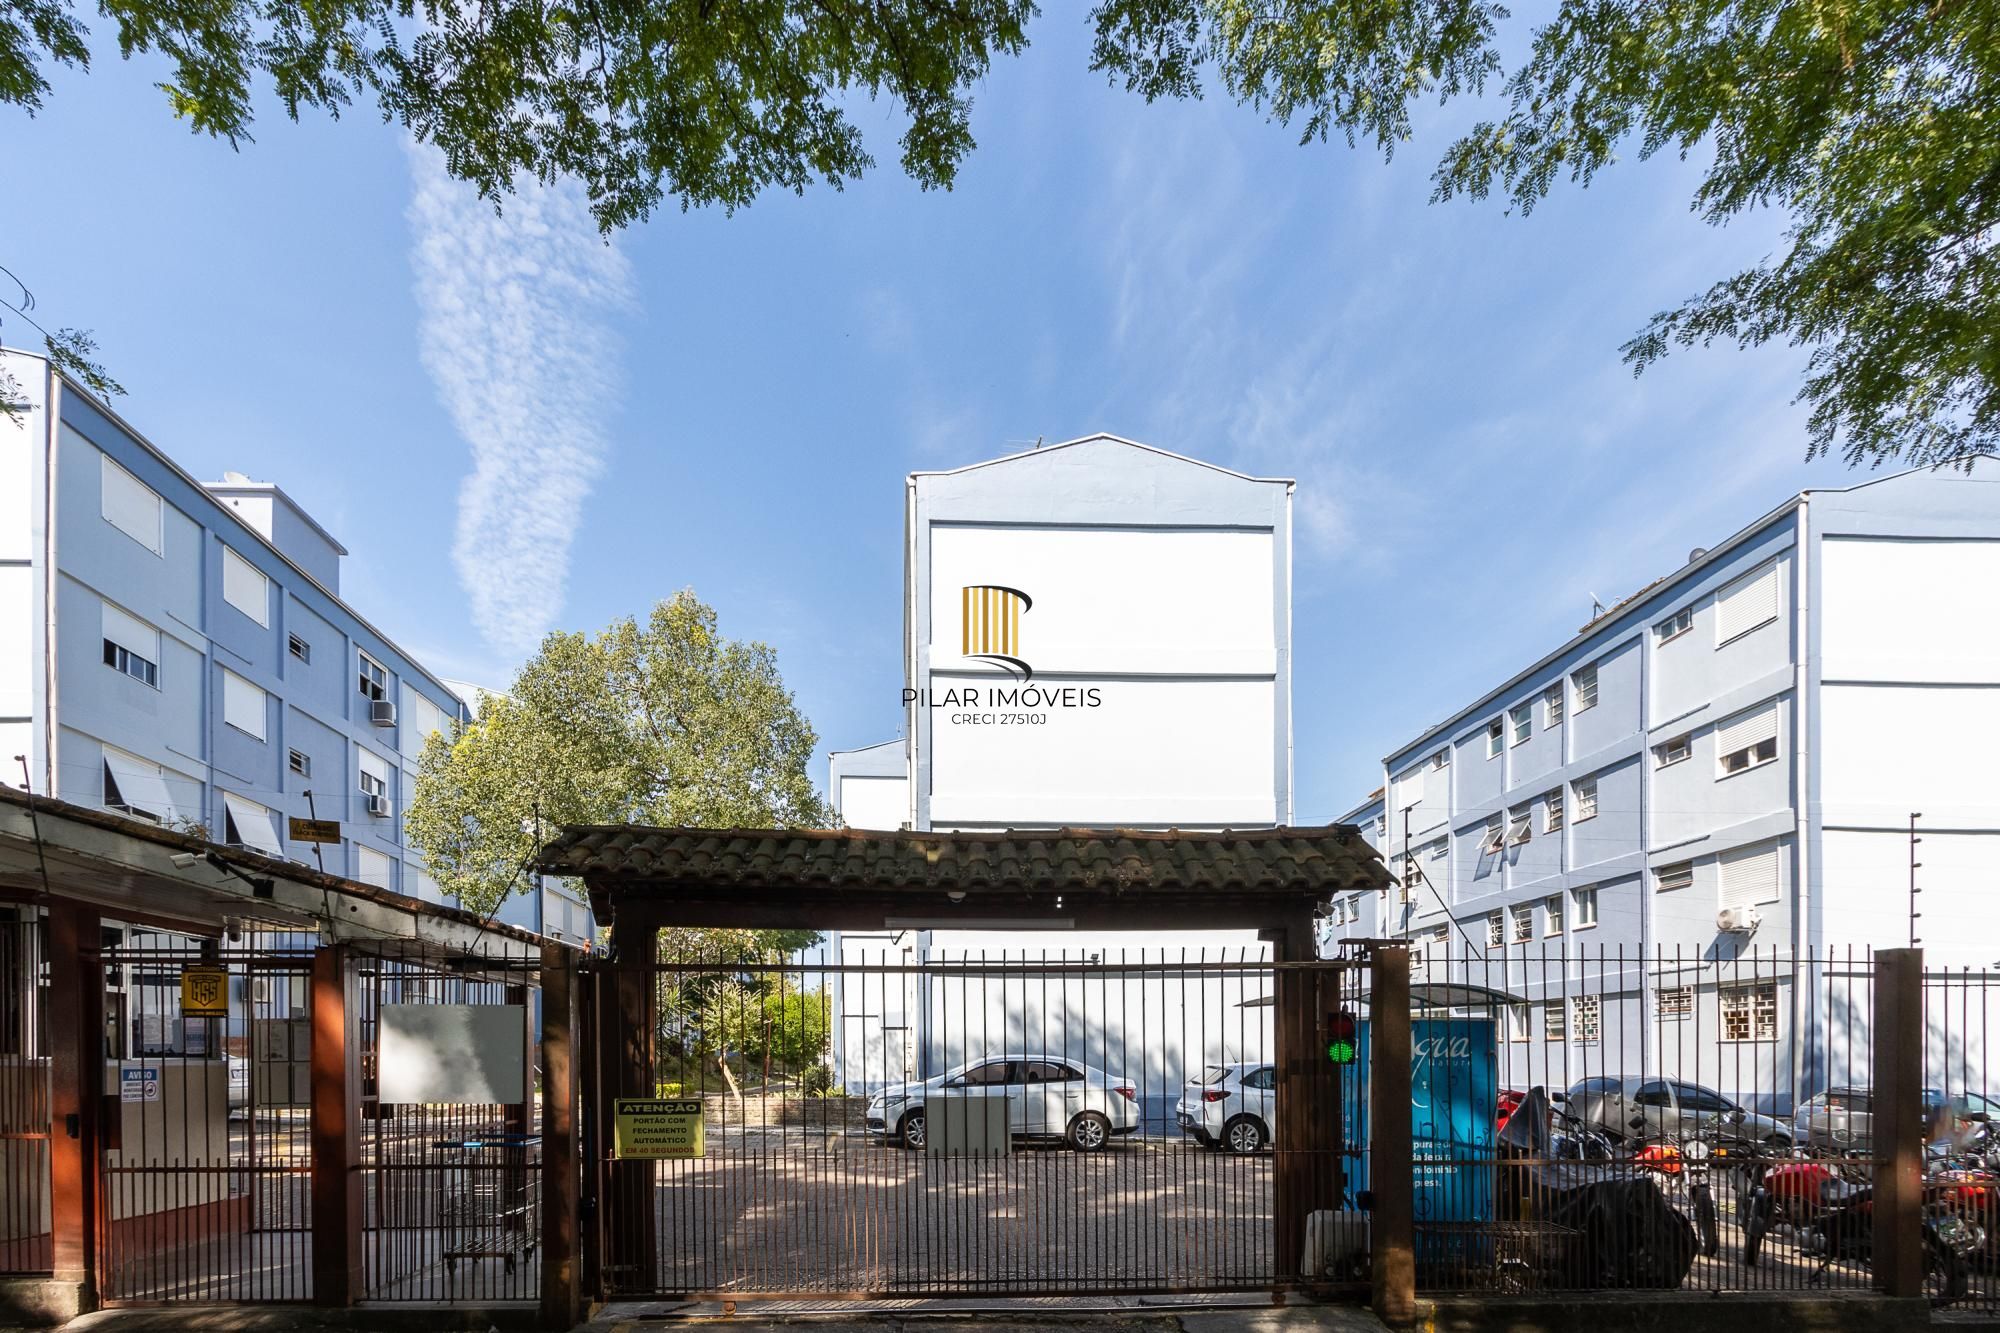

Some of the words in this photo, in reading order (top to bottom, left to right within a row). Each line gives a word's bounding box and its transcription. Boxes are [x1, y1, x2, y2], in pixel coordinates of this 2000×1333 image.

[623, 1103, 697, 1114] ATENÇÃO
[633, 1127, 687, 1135] FECHAMENTO
[650, 1146, 695, 1154] SEGUNDOS
